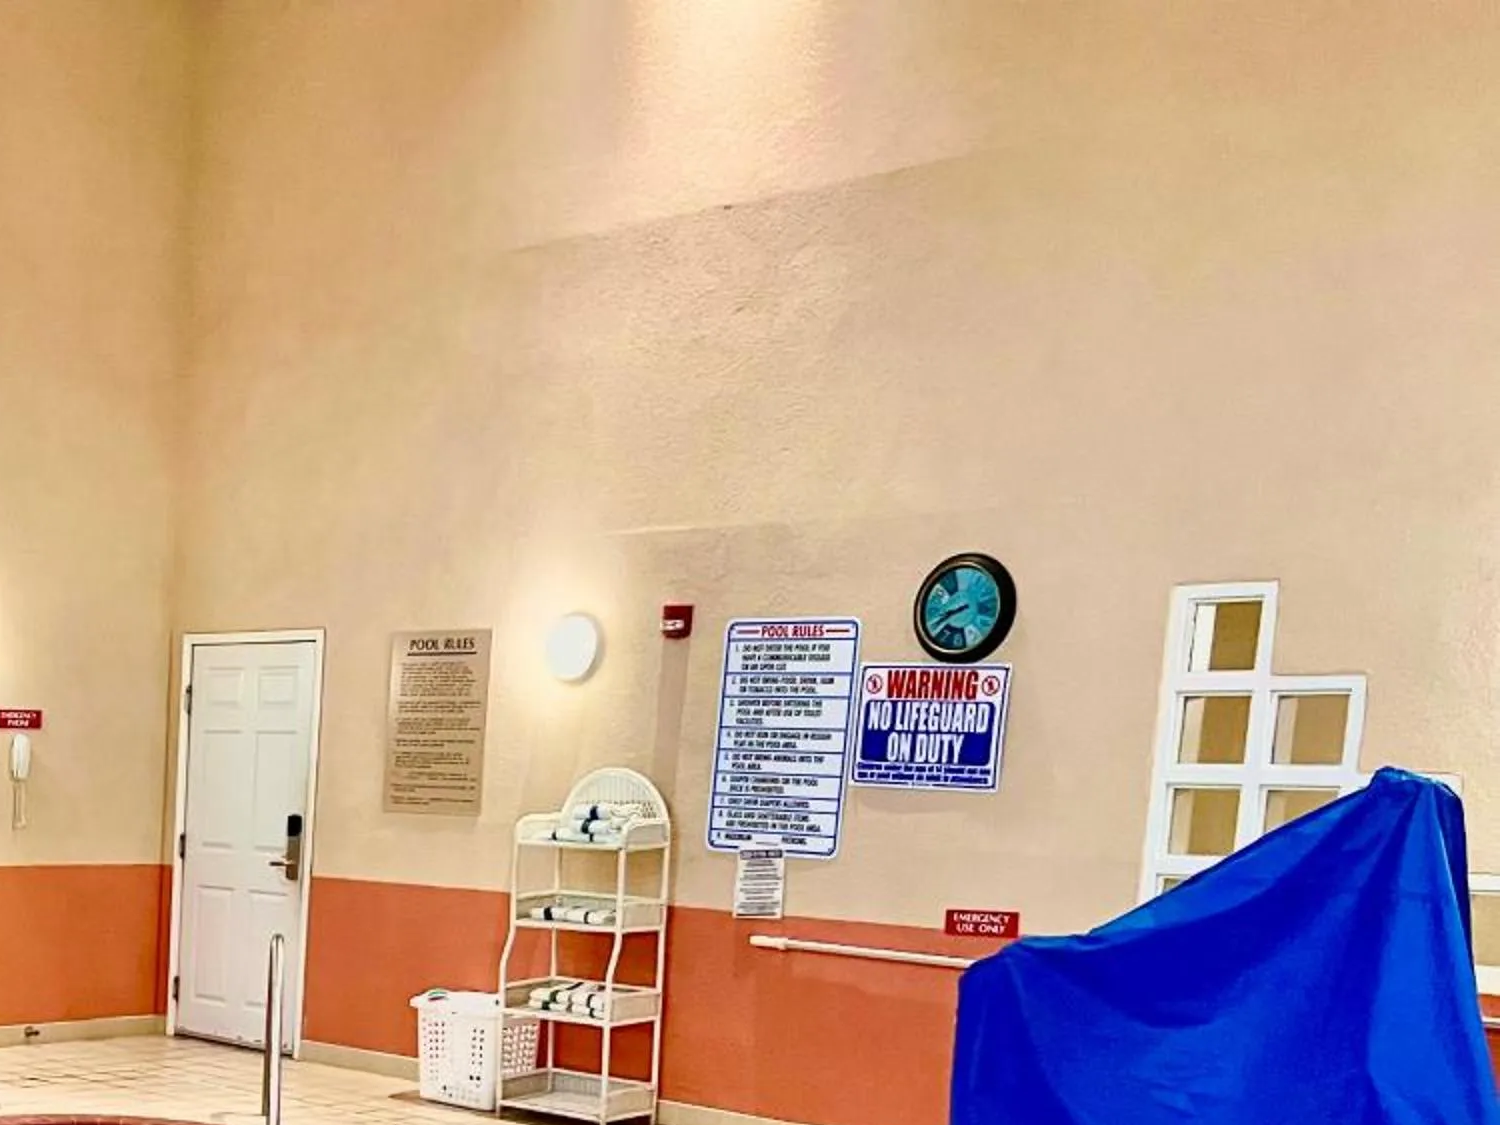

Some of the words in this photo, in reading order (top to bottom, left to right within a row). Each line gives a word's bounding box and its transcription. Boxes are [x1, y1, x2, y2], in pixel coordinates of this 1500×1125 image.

[762, 626, 788, 637] POOL
[792, 625, 824, 637] RULES
[410, 640, 439, 650] POOL
[886, 670, 979, 700] WARNING
[868, 701, 893, 731] NO
[895, 701, 991, 733] LIFEGUARD
[887, 731, 912, 762] ON
[914, 733, 965, 764] DUTY
[953, 912, 1010, 924] EMERGENCY
[979, 923, 1006, 934] ONLY
